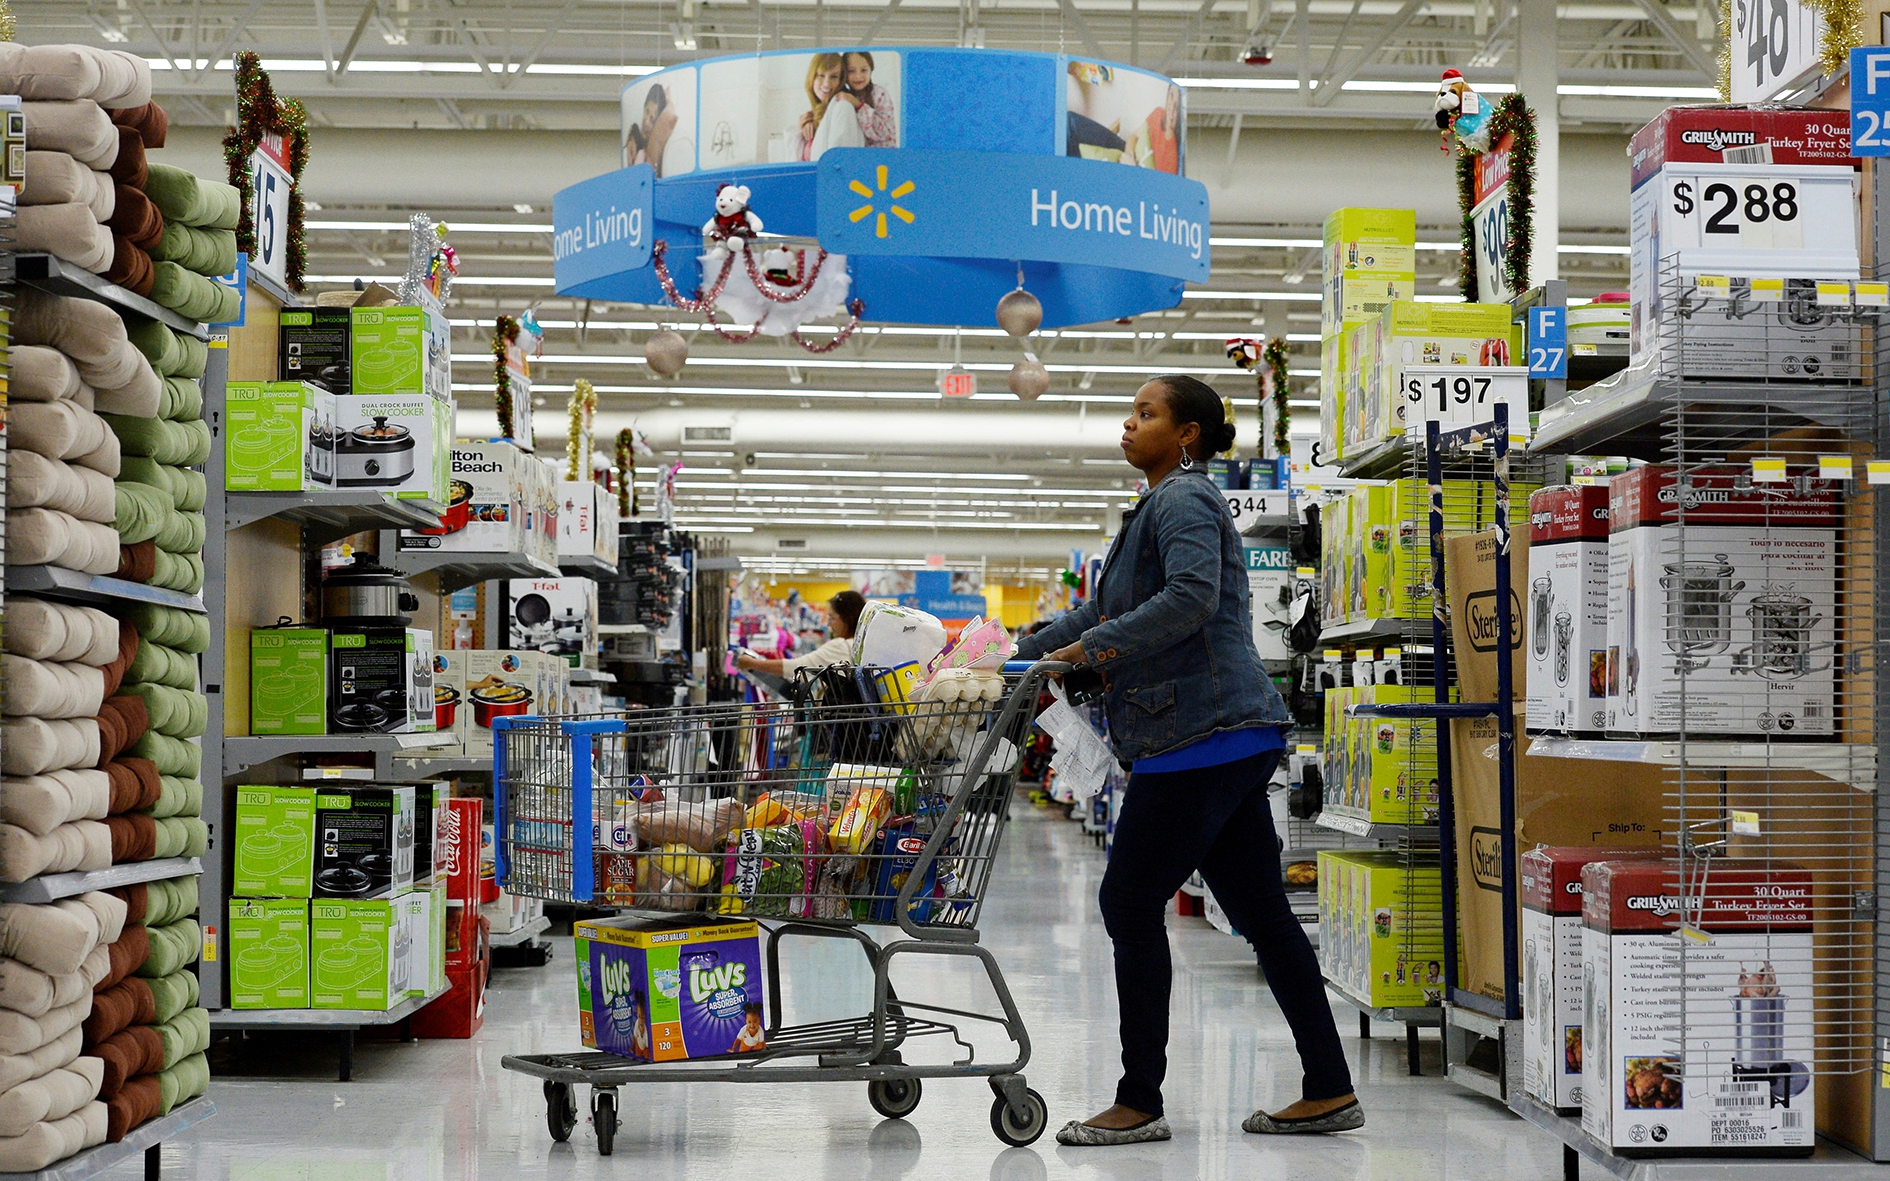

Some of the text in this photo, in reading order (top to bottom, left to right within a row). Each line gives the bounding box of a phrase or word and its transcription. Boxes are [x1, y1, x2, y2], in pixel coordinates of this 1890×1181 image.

[1805, 124, 1819, 135] 30
[1765, 136, 1804, 151] Turkey
[1807, 137, 1838, 151] Fryer
[586, 205, 642, 247] Living
[1031, 188, 1202, 260] Home Living
[1539, 310, 1556, 338] F
[1530, 347, 1564, 372] 27
[945, 374, 972, 396] EXIT
[361, 409, 424, 417] SLOW COOKER
[452, 462, 503, 473] Beach
[1770, 683, 1795, 691] Hervir
[1608, 822, 1646, 833] Ship To:
[607, 867, 635, 876] SUGAR
[1753, 886, 1806, 898] 30 Quart
[651, 931, 689, 943] SUPER VALUE!
[702, 929, 717, 937] Money
[730, 925, 754, 934] Guarantee!
[709, 995, 746, 1010] ABSORBENT
[664, 1027, 670, 1036] 3
[658, 1042, 671, 1050] 120
[1730, 1133, 1767, 1141] 551618247
